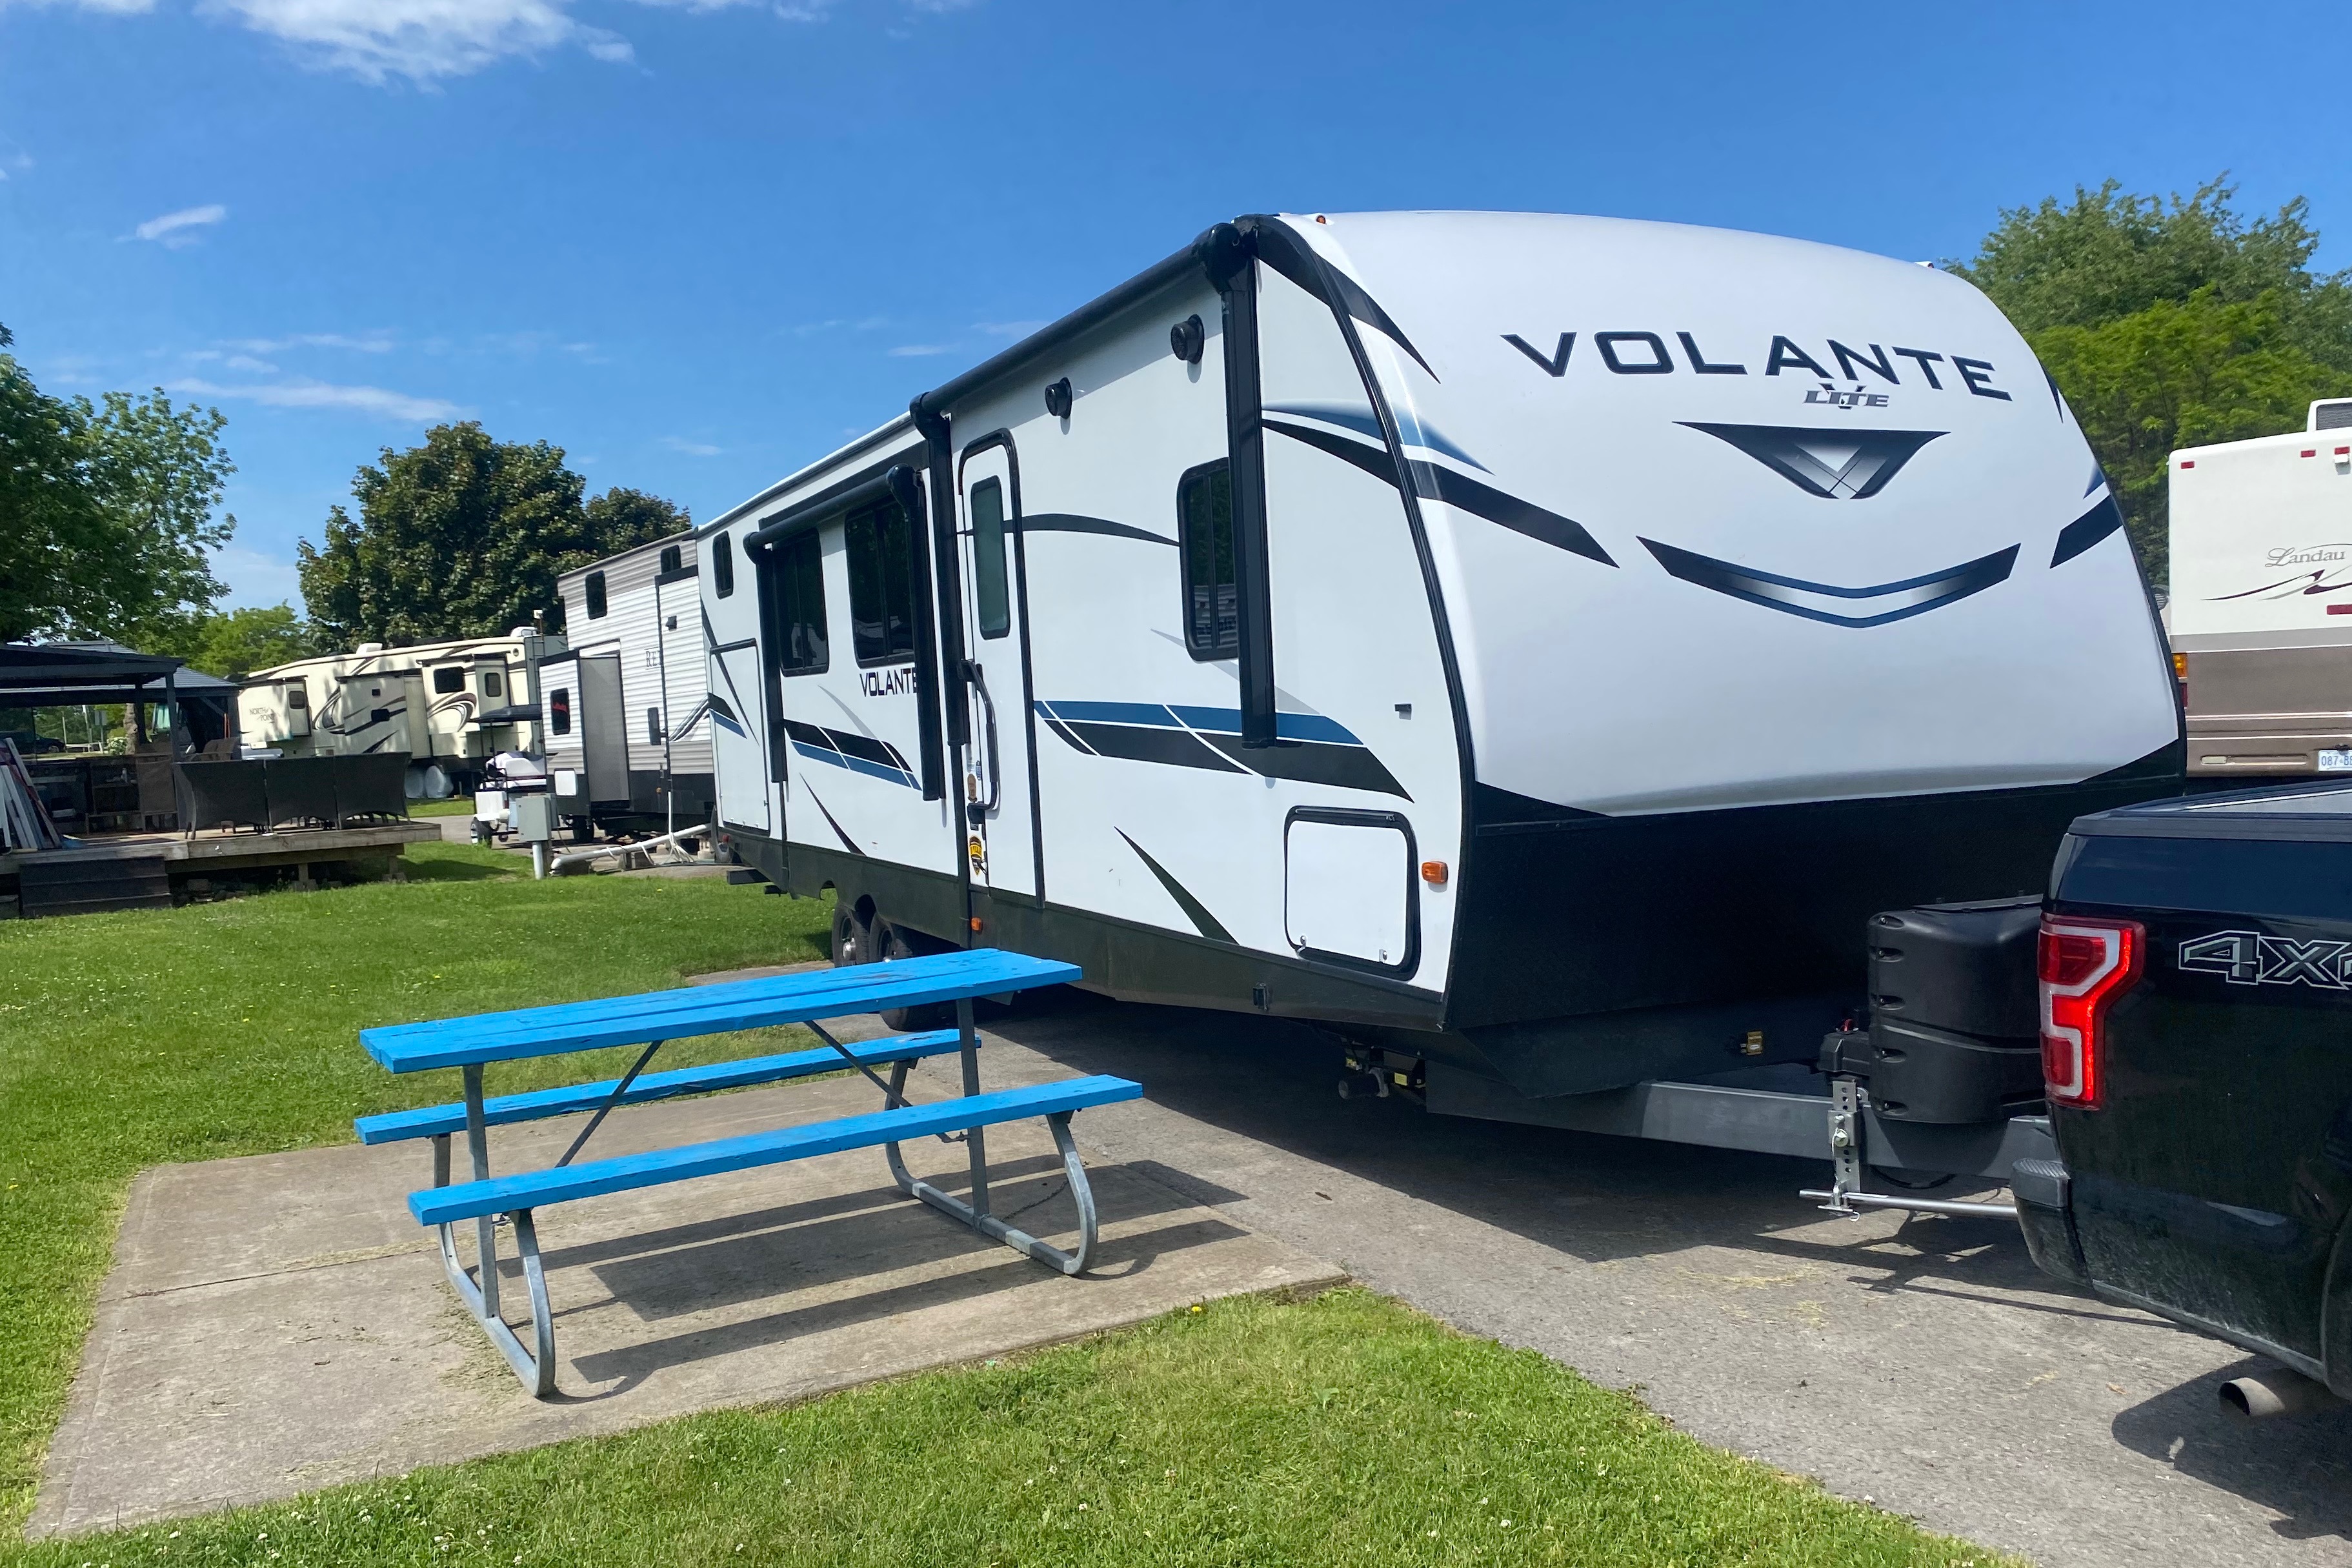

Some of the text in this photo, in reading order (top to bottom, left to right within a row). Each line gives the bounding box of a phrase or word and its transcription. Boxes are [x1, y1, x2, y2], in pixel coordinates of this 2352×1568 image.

[1500, 331, 2013, 401] VOLANTE
[1802, 390, 1889, 407] LITE
[2265, 547, 2346, 567] Landau
[2178, 930, 2352, 990] 4X
